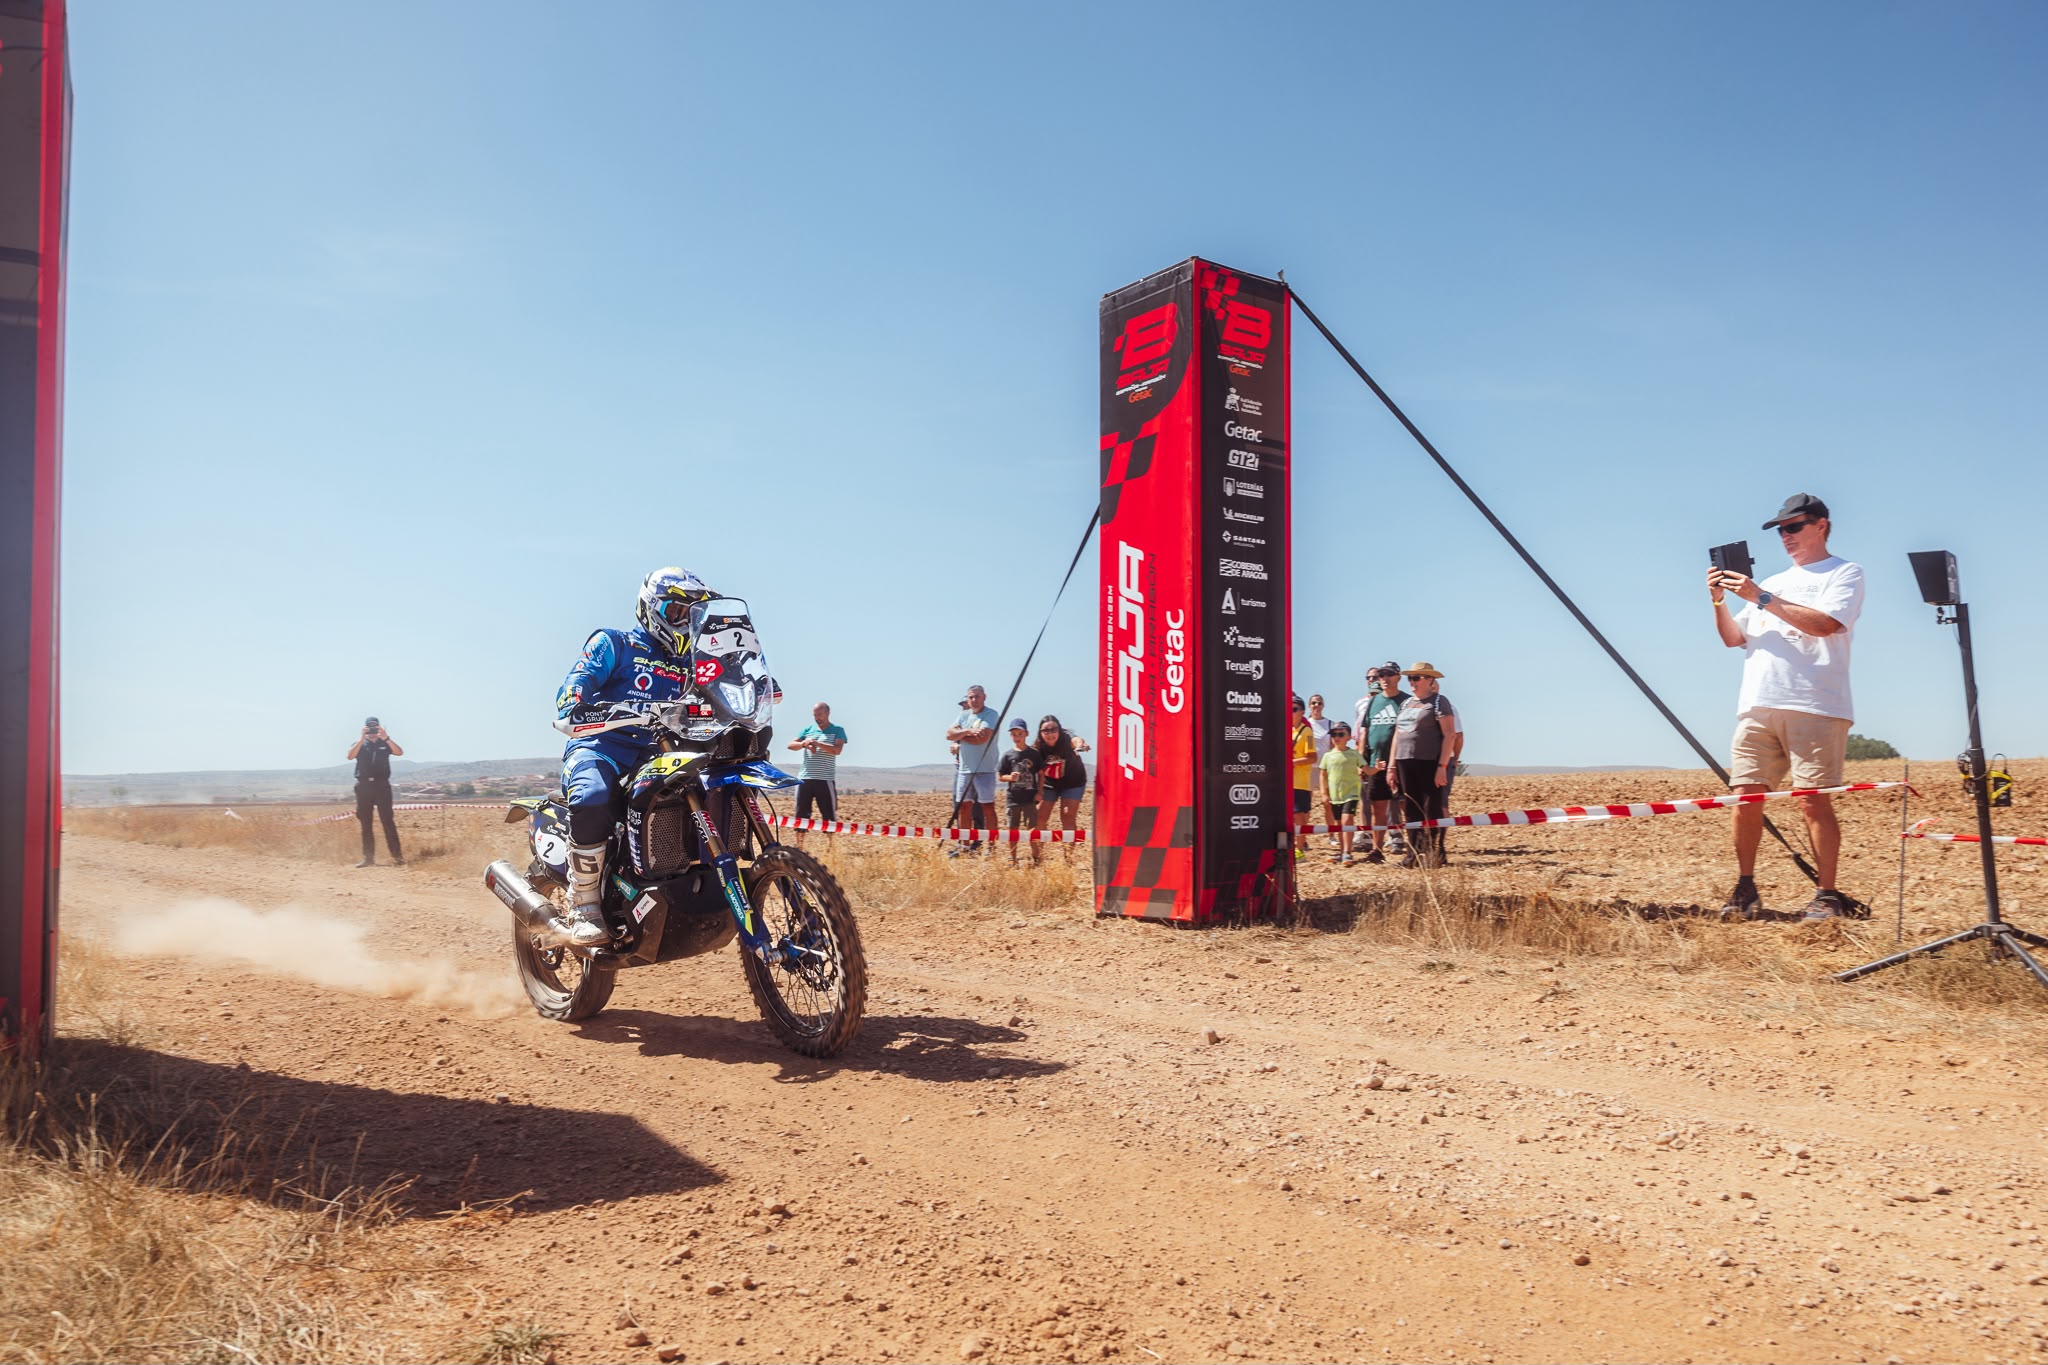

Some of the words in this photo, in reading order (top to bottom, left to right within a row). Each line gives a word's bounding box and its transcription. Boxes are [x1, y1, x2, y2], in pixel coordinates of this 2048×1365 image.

[1128, 387, 1153, 403] Getac
[1224, 420, 1263, 443] Getac
[1228, 449, 1260, 469] GT2i
[733, 631, 745, 647] 2
[1118, 540, 1145, 780] BAJA
[1161, 608, 1185, 714] Getac
[697, 662, 717, 677] +2
[1226, 690, 1262, 705] Chubb
[1371, 717, 1397, 726] adida
[1232, 788, 1257, 801] CRUZ
[543, 841, 554, 858] 2
[730, 893, 745, 921] MOTOREX
